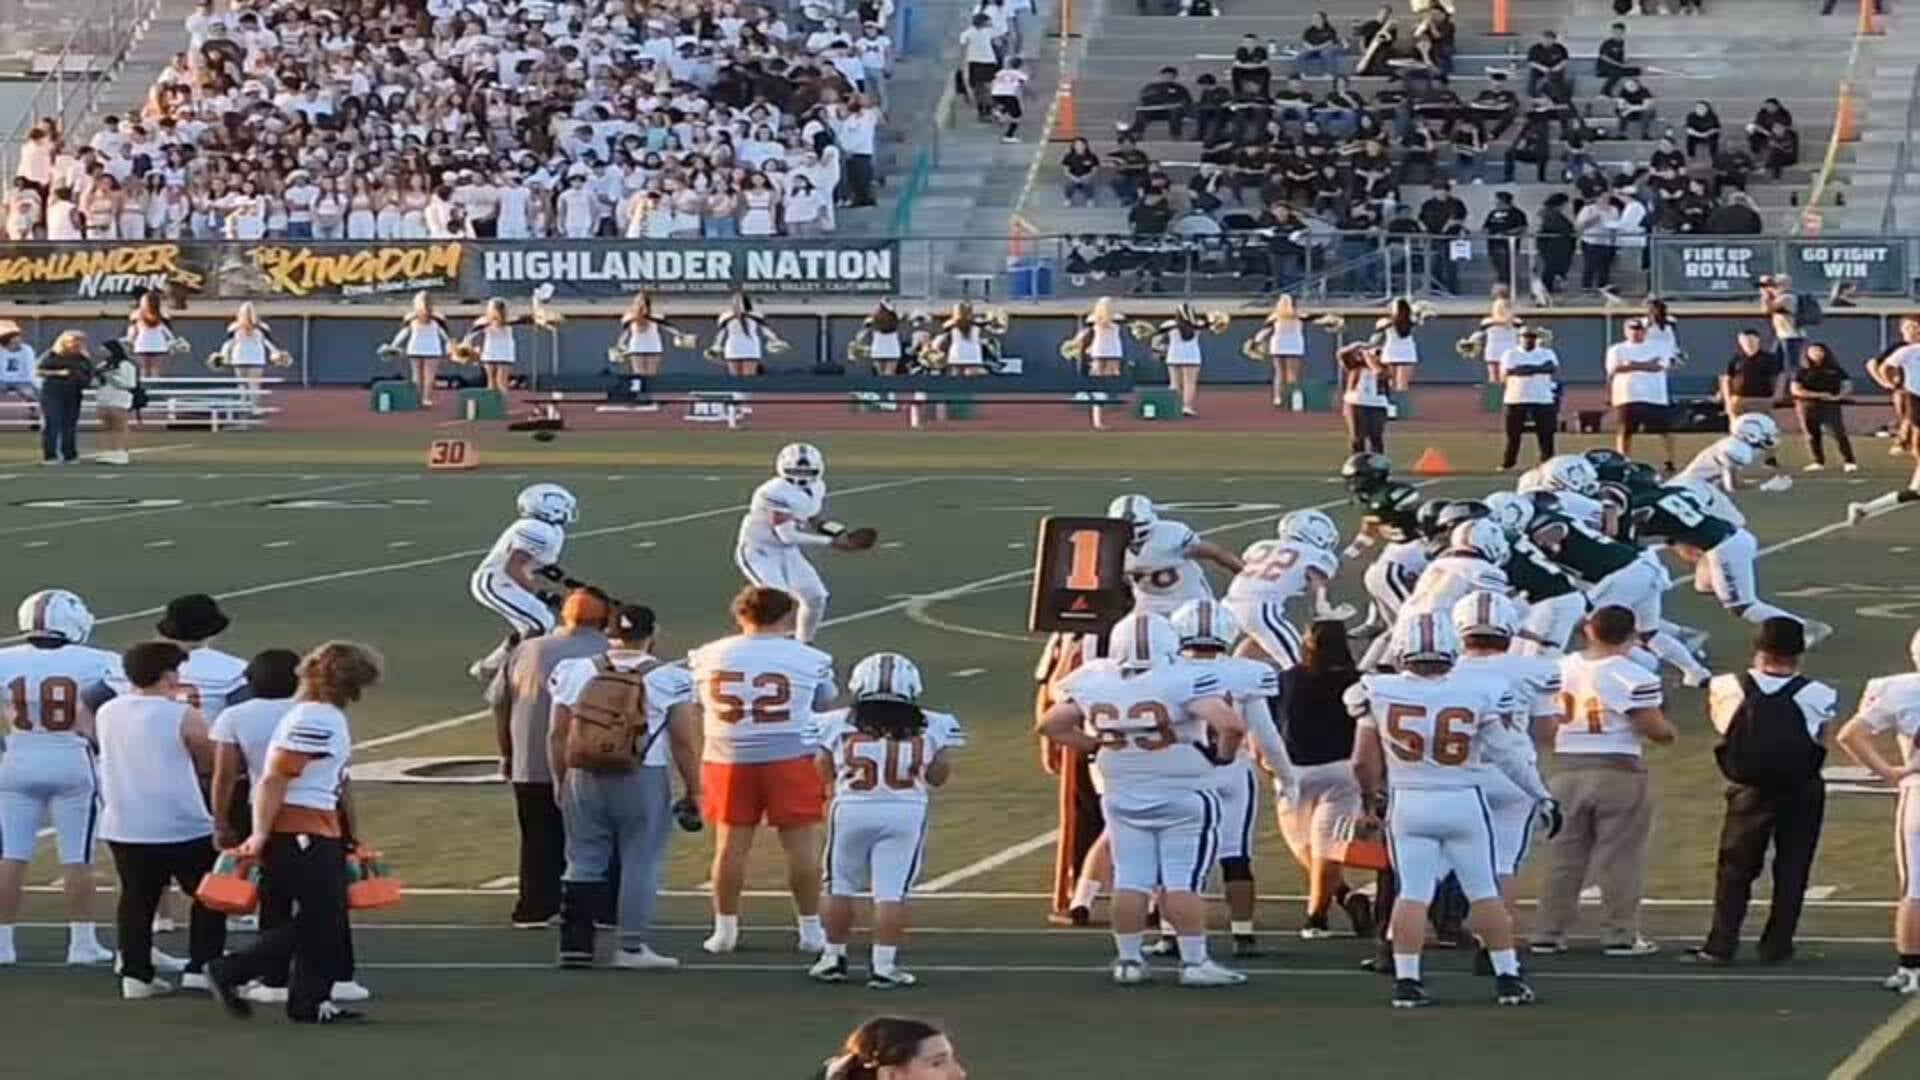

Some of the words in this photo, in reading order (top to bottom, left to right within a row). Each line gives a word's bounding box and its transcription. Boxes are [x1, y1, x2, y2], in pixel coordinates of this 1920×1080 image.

[266, 242, 461, 297] KINGDOM
[483, 250, 731, 280] HIGHLANDER
[746, 249, 891, 280] NATION
[1683, 247, 1726, 262] FIRE
[1728, 247, 1752, 262] UP
[1685, 262, 1751, 278] ROYAL
[1803, 247, 1828, 262] GO
[1832, 247, 1888, 262] FIGHT
[1823, 262, 1868, 278] WIN
[78, 273, 169, 298] NATION
[432, 441, 465, 465] 30
[1066, 529, 1101, 590] 1
[6, 675, 78, 732] 18
[709, 671, 792, 724] 52
[1386, 702, 1475, 766] 56
[845, 732, 924, 791] 50
